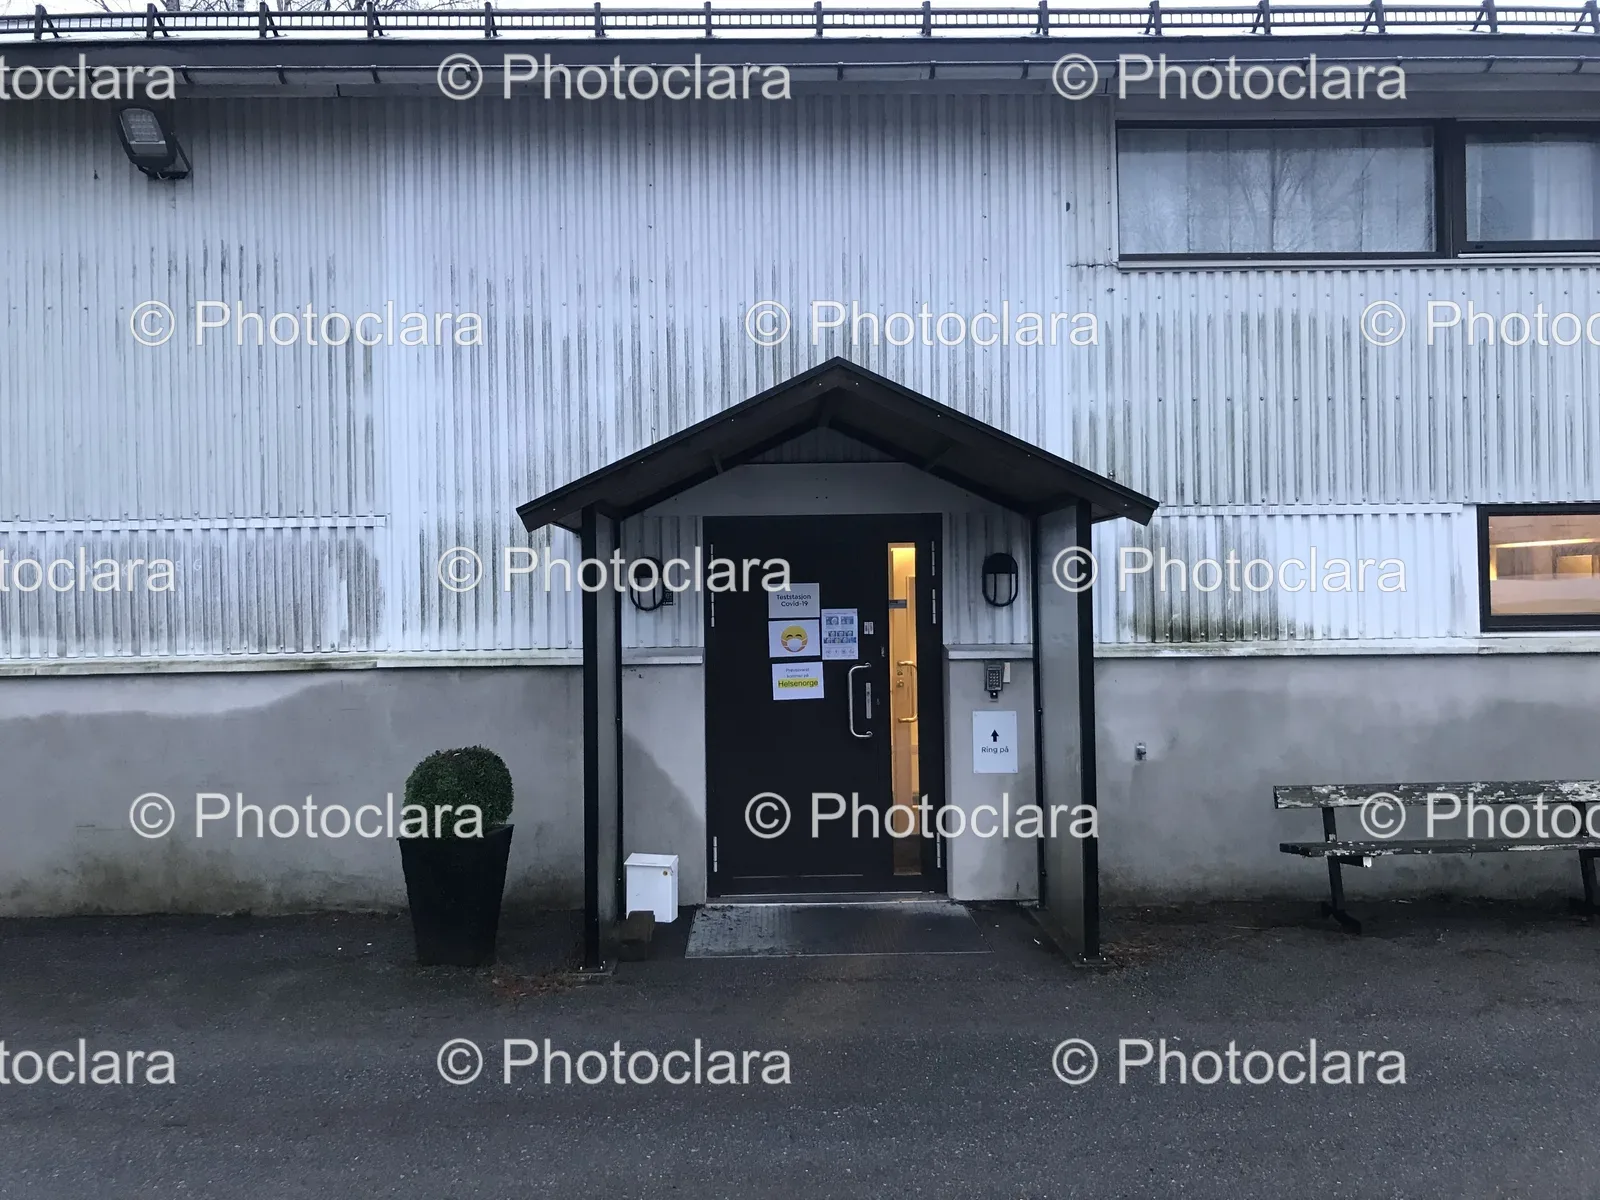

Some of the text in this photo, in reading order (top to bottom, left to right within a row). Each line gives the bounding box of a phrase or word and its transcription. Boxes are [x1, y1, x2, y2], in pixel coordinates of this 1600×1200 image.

[778, 680, 819, 688] Helsenorge
[981, 745, 1009, 754] Ring på
